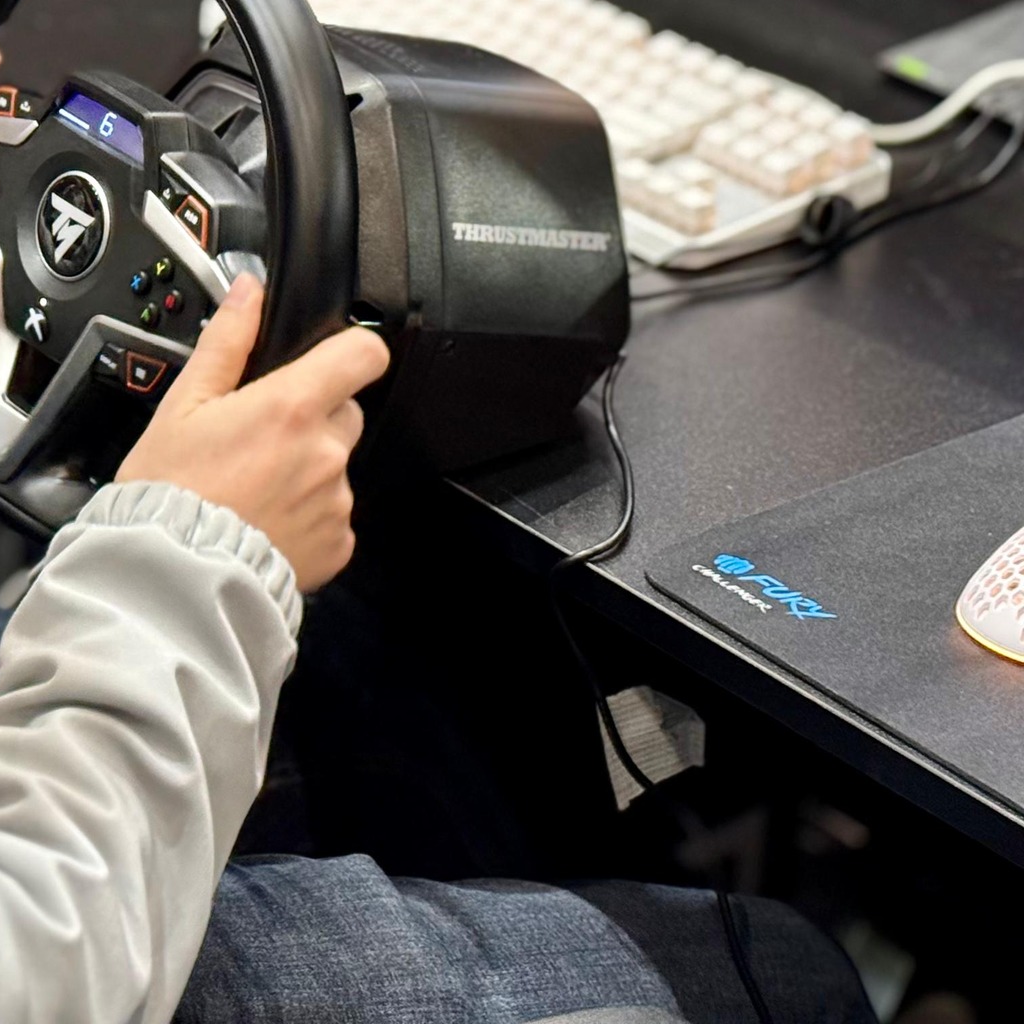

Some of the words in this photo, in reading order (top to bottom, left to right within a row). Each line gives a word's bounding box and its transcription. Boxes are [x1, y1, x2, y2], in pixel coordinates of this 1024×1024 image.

[99, 111, 118, 137] 6
[452, 222, 608, 252] THRUSTMASTER
[130, 274, 142, 290] X
[156, 262, 166, 276] Y
[738, 576, 837, 620] FURY
